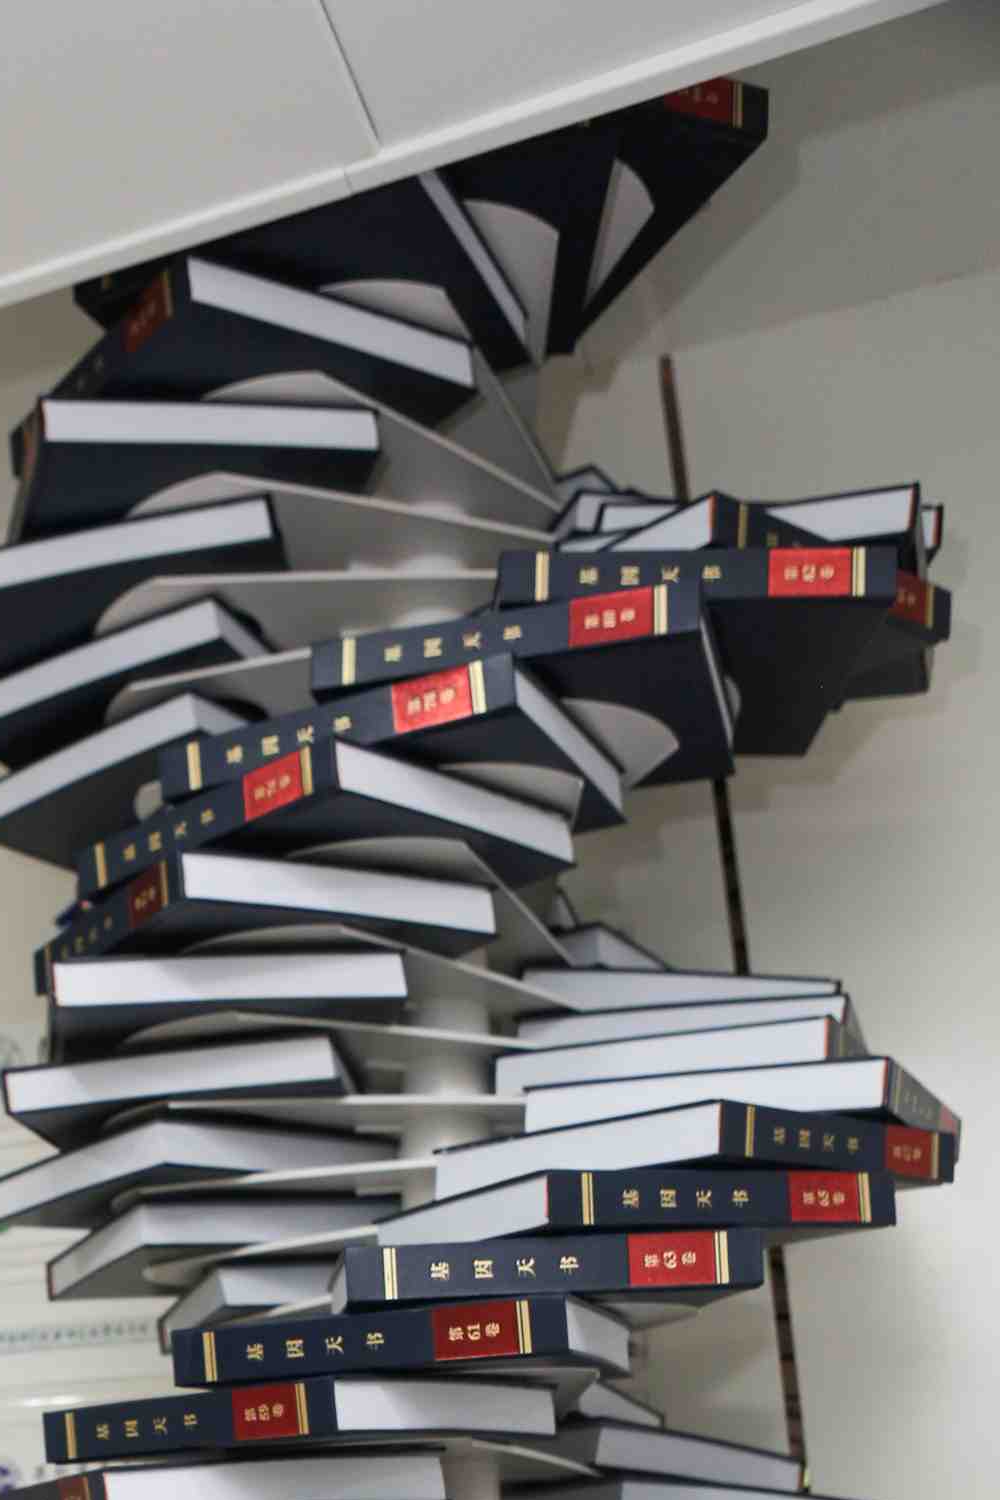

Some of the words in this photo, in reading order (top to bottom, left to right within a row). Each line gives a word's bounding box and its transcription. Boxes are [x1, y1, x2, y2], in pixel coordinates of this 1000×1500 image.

[578, 563, 721, 586] 基因天书
[384, 624, 523, 663] 基因天书
[225, 715, 352, 765] 基因天书
[622, 1188, 749, 1208] 基因天书
[430, 1256, 579, 1281] 基因天书
[644, 1250, 697, 1270] 第63卷
[246, 1332, 385, 1361] 基因天书
[448, 1322, 500, 1342] 第61卷
[96, 1413, 198, 1440] 基因天书
